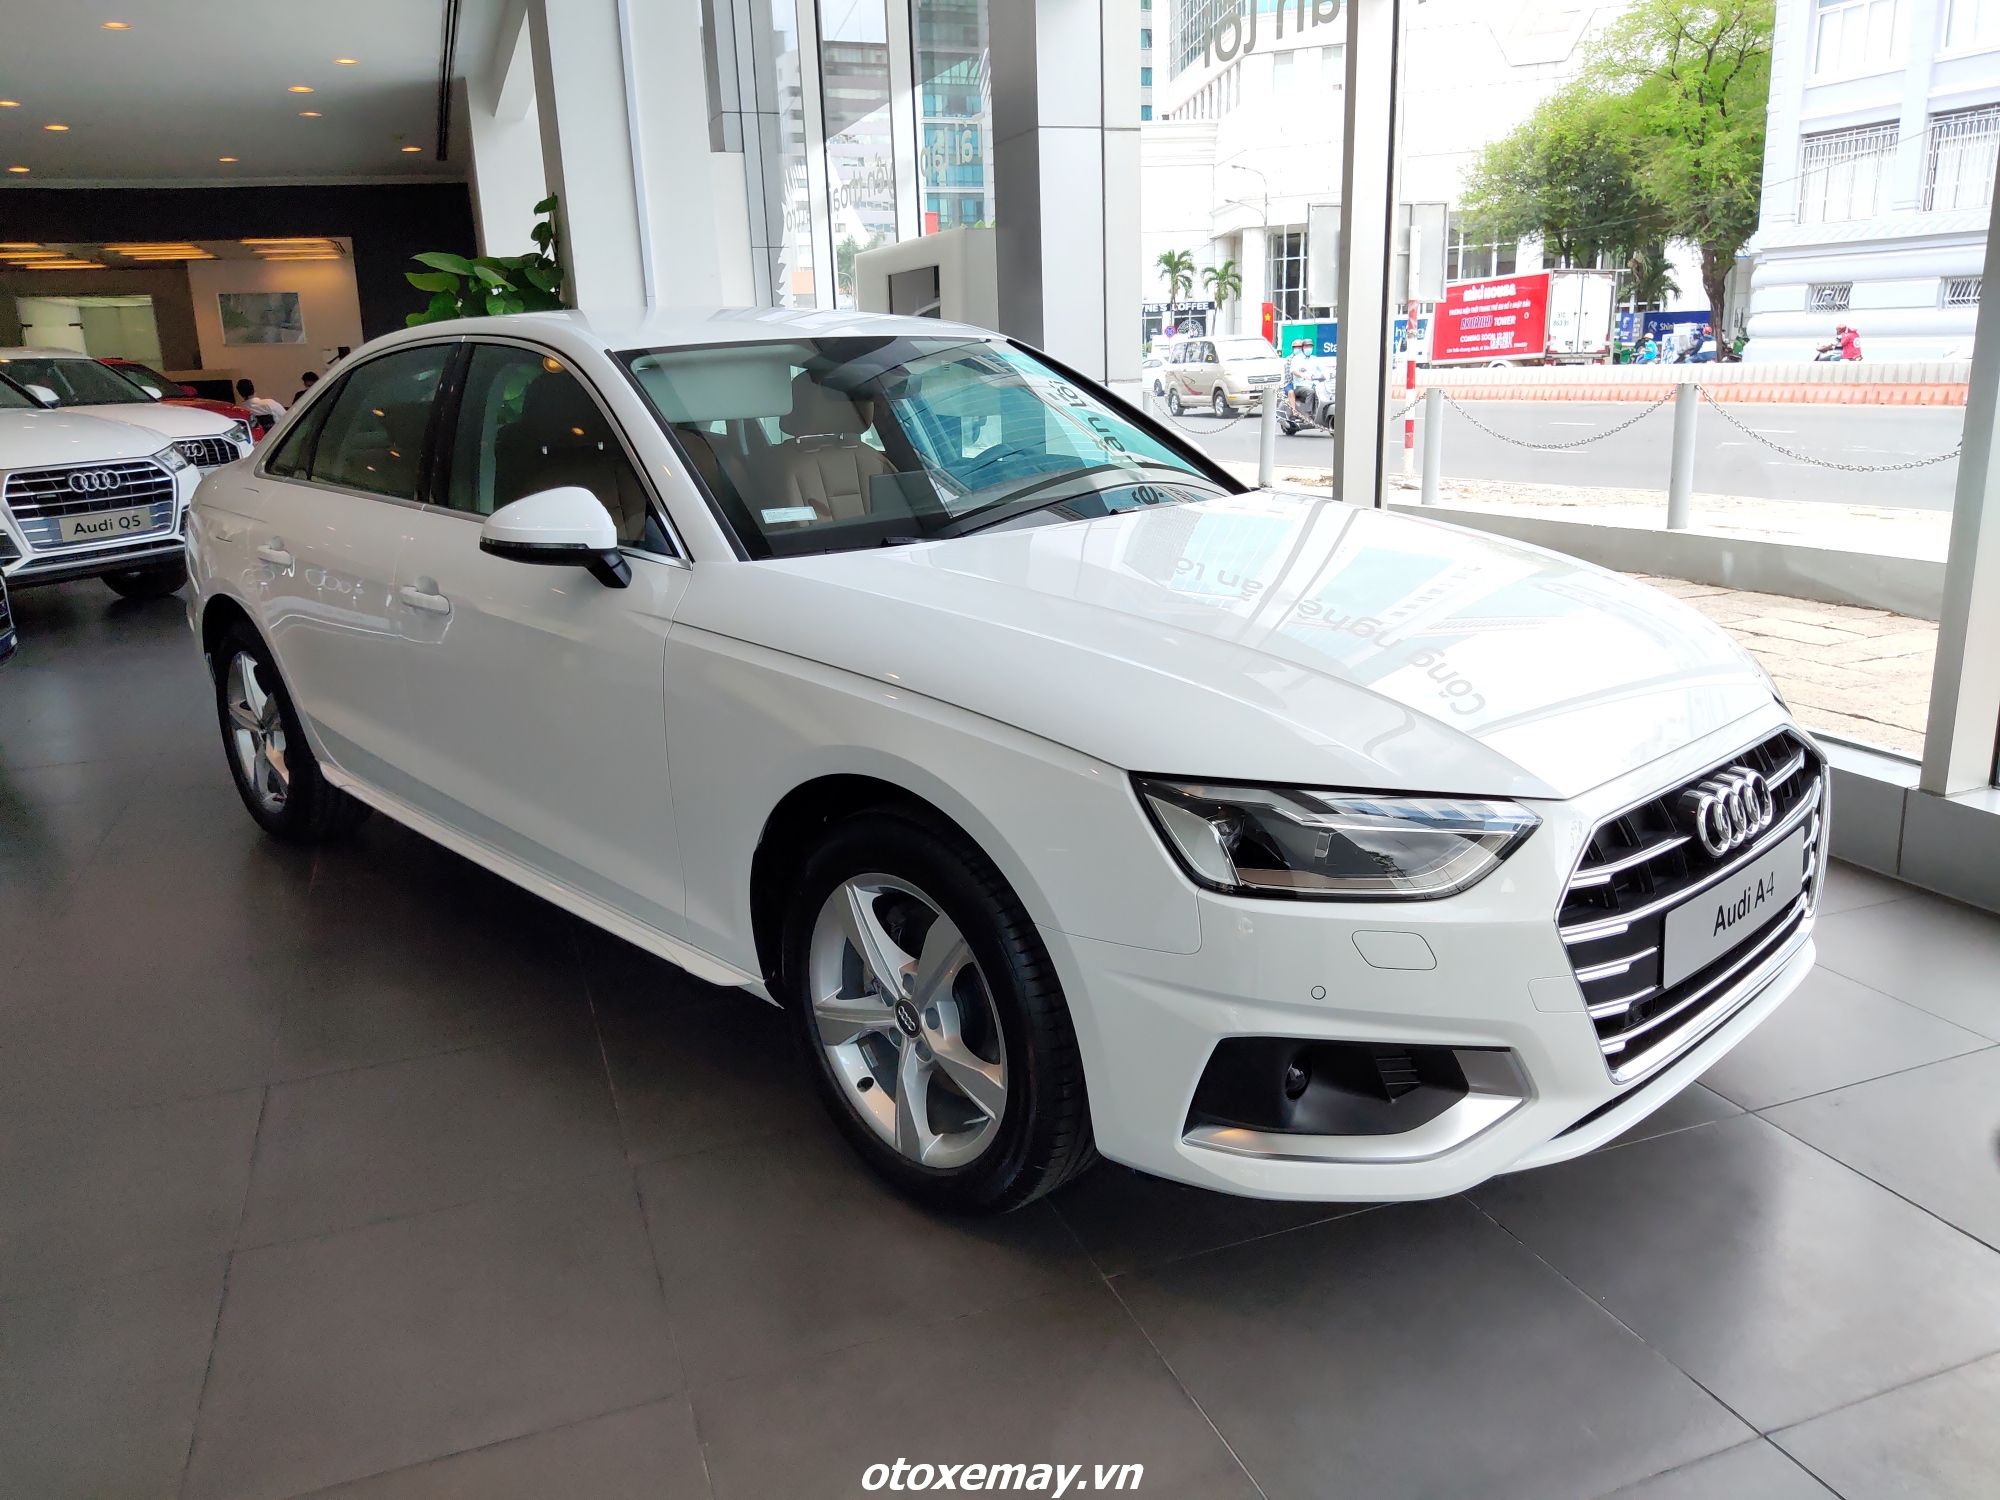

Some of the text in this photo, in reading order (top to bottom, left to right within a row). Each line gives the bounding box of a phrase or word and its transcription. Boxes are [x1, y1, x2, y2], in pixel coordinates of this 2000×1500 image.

[1494, 316, 1516, 326] TOWER
[73, 515, 141, 536] Audi Q5
[1712, 871, 1775, 937] Audi A4
